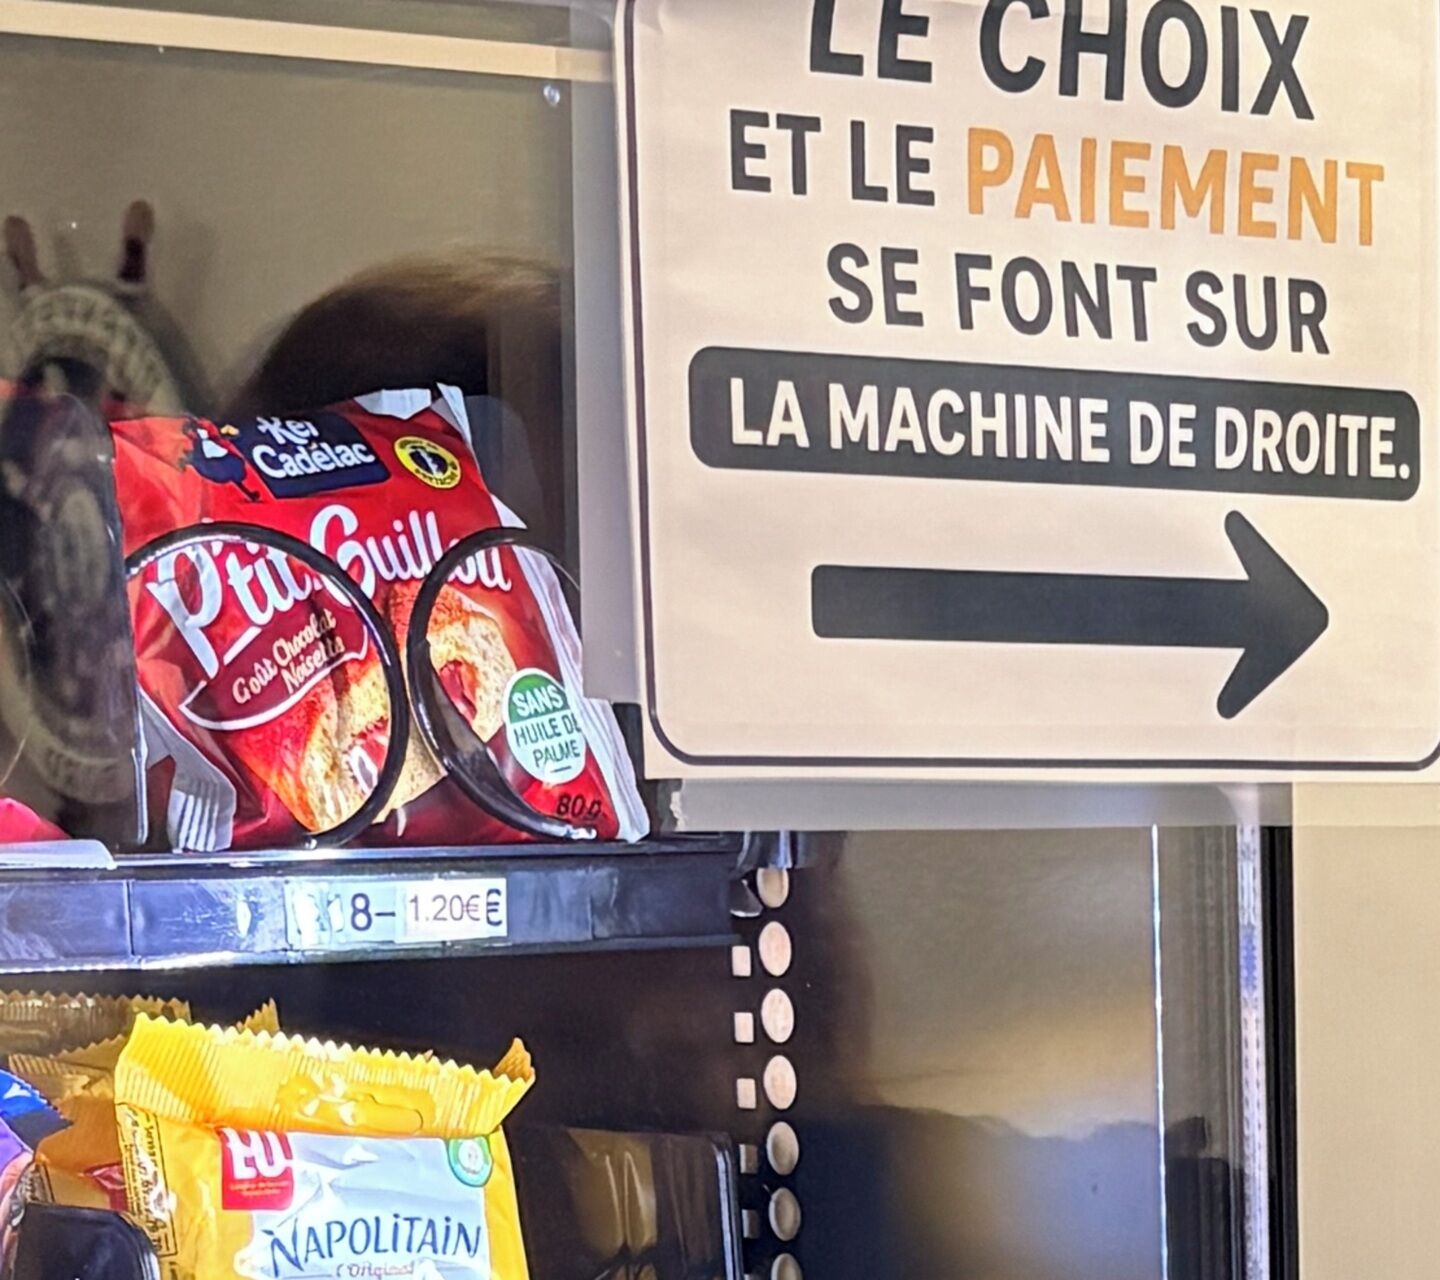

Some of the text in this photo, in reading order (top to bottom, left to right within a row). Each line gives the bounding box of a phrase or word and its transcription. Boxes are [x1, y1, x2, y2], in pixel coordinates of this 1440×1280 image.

[810, 0, 1314, 120] LE CHOIX
[729, 109, 1384, 246] ET LE PAIEMENT
[826, 243, 1330, 354] SE FONT SUR
[729, 377, 1410, 480] LA MACHINE DE DROITE.
[252, 440, 376, 480] Cadélac
[231, 607, 338, 704] Goût Chocolat
[280, 635, 346, 696] Noisette
[512, 683, 564, 718] SANS
[513, 717, 562, 748] HUILE
[532, 739, 581, 769] PALME
[408, 894, 481, 923] 1.20€
